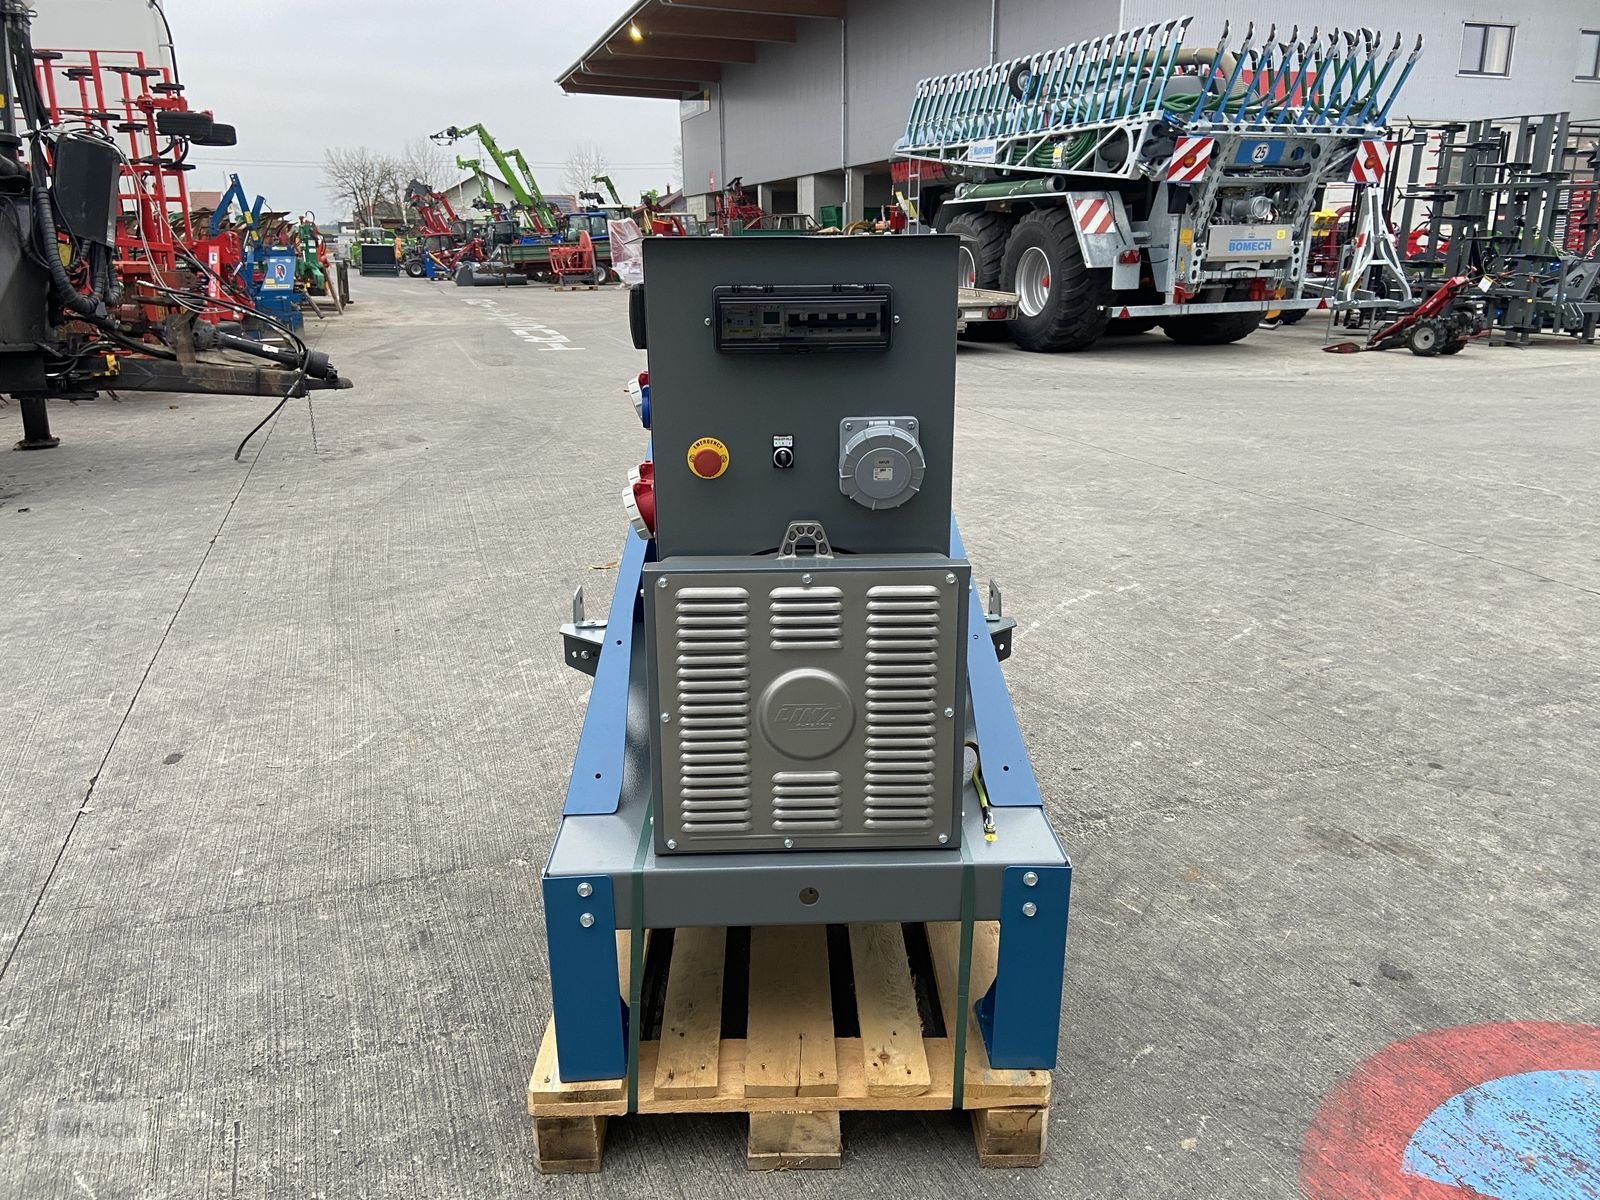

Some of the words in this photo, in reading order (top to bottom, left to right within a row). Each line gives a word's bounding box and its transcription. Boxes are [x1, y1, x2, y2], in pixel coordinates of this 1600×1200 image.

[1254, 147, 1267, 159] 25
[1228, 242, 1272, 252] BOMECH
[692, 438, 724, 449] EMERGENCY
